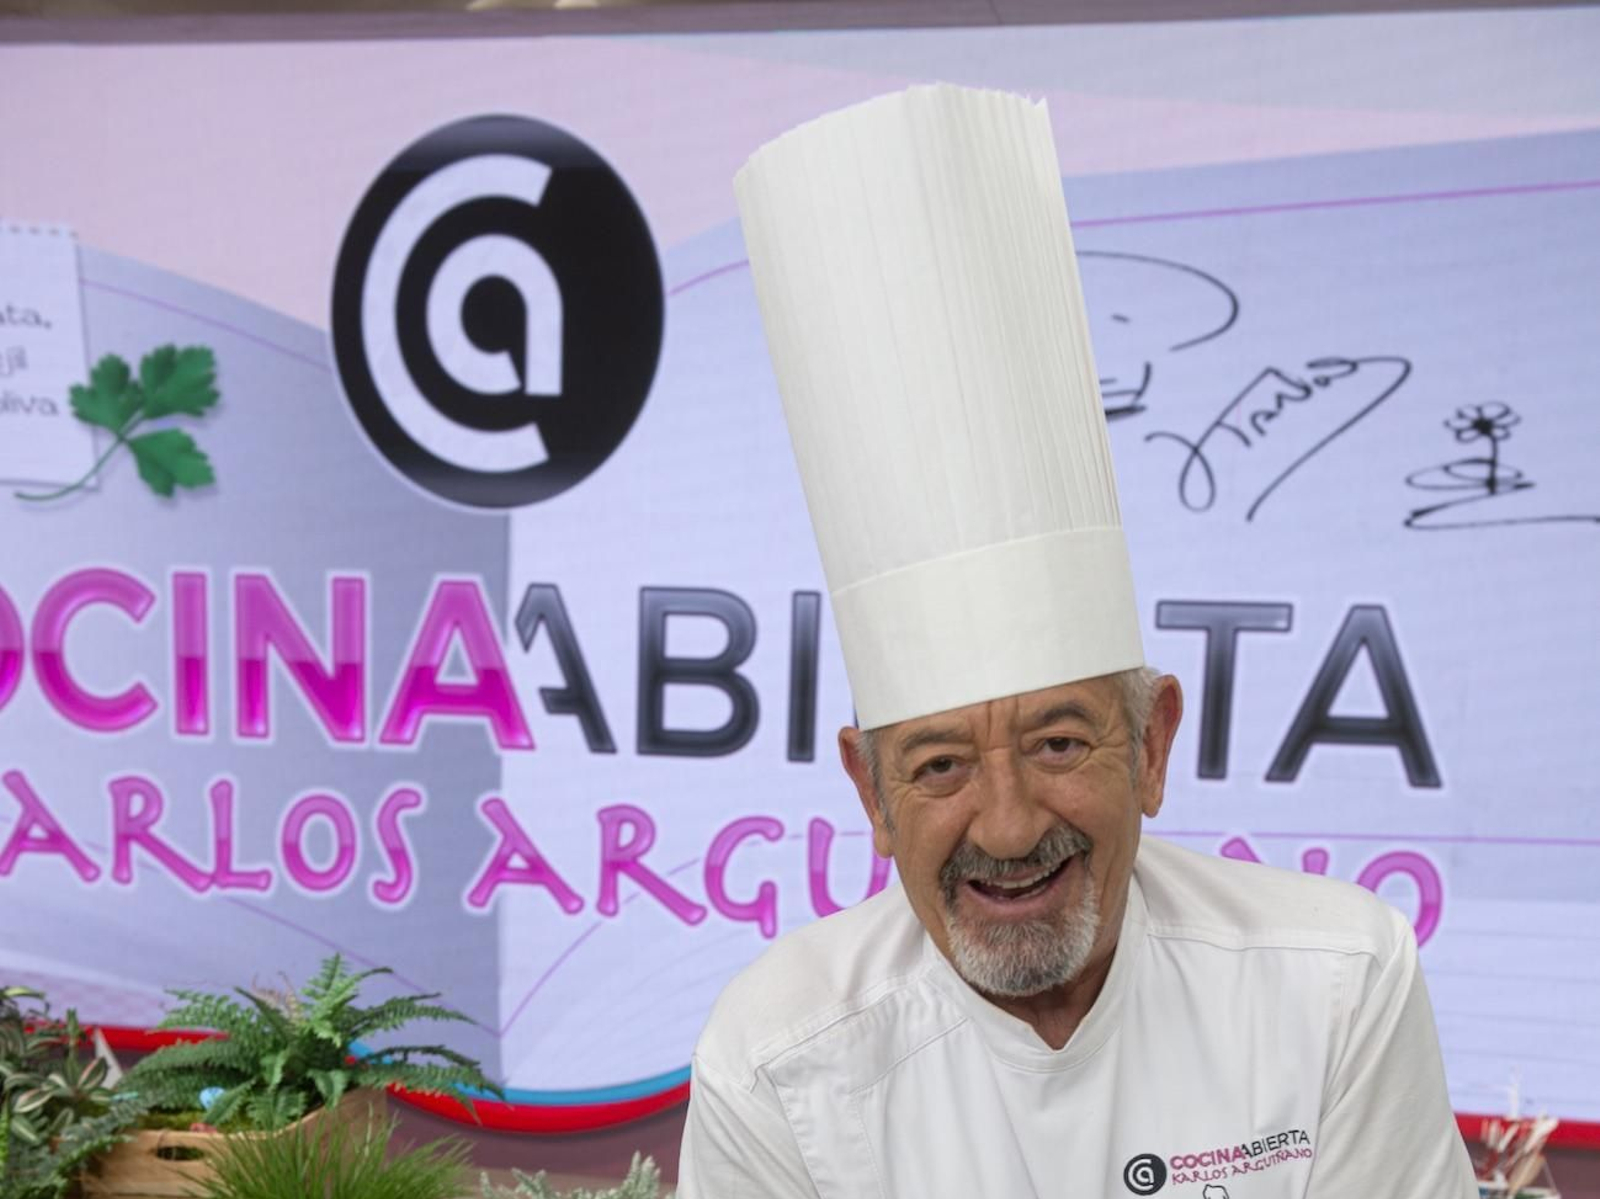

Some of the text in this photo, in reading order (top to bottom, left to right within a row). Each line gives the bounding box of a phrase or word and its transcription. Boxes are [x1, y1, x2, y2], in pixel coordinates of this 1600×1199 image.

[0, 567, 1442, 789] CINAABITA
[1172, 1148, 1313, 1185] KARLOS ARGUIÑANO
